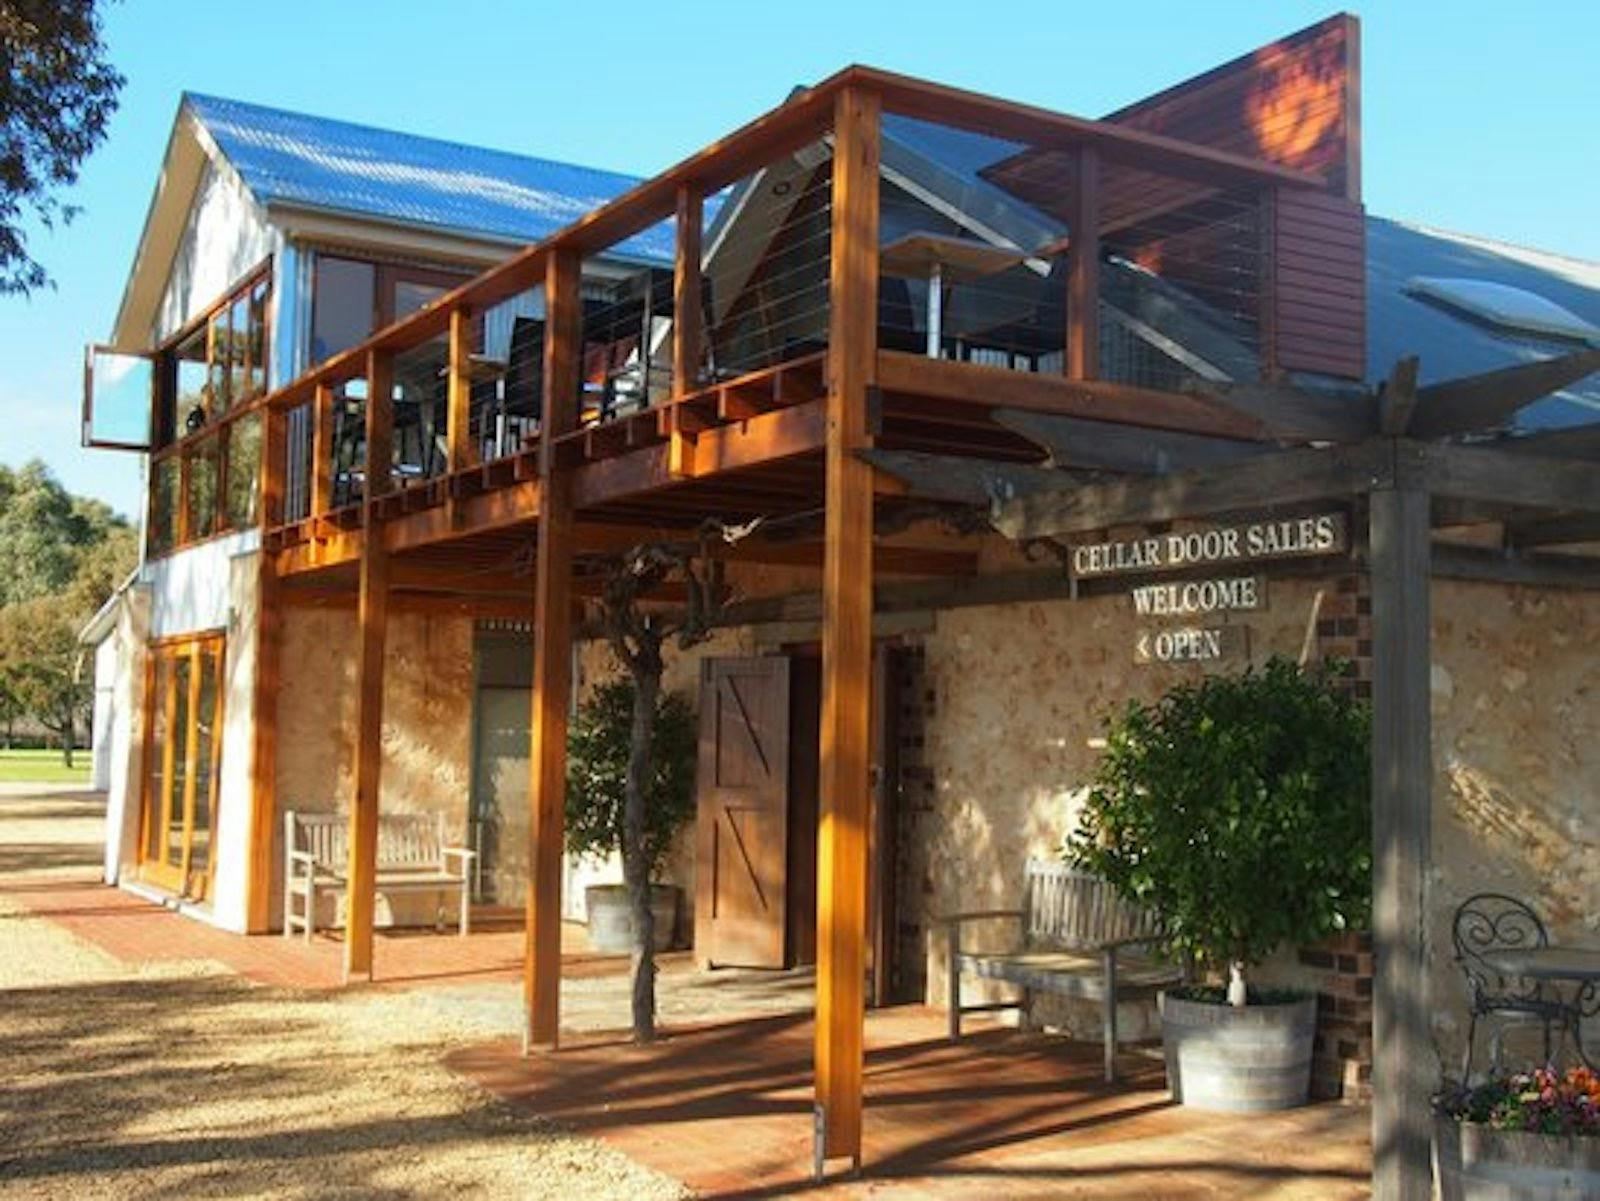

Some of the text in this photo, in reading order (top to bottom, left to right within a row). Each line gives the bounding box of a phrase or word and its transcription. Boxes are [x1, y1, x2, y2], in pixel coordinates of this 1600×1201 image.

[1074, 516, 1334, 574] CELLAR DOOR SALES
[1133, 578, 1258, 615] WELCOME
[1156, 629, 1222, 661] OPEN
